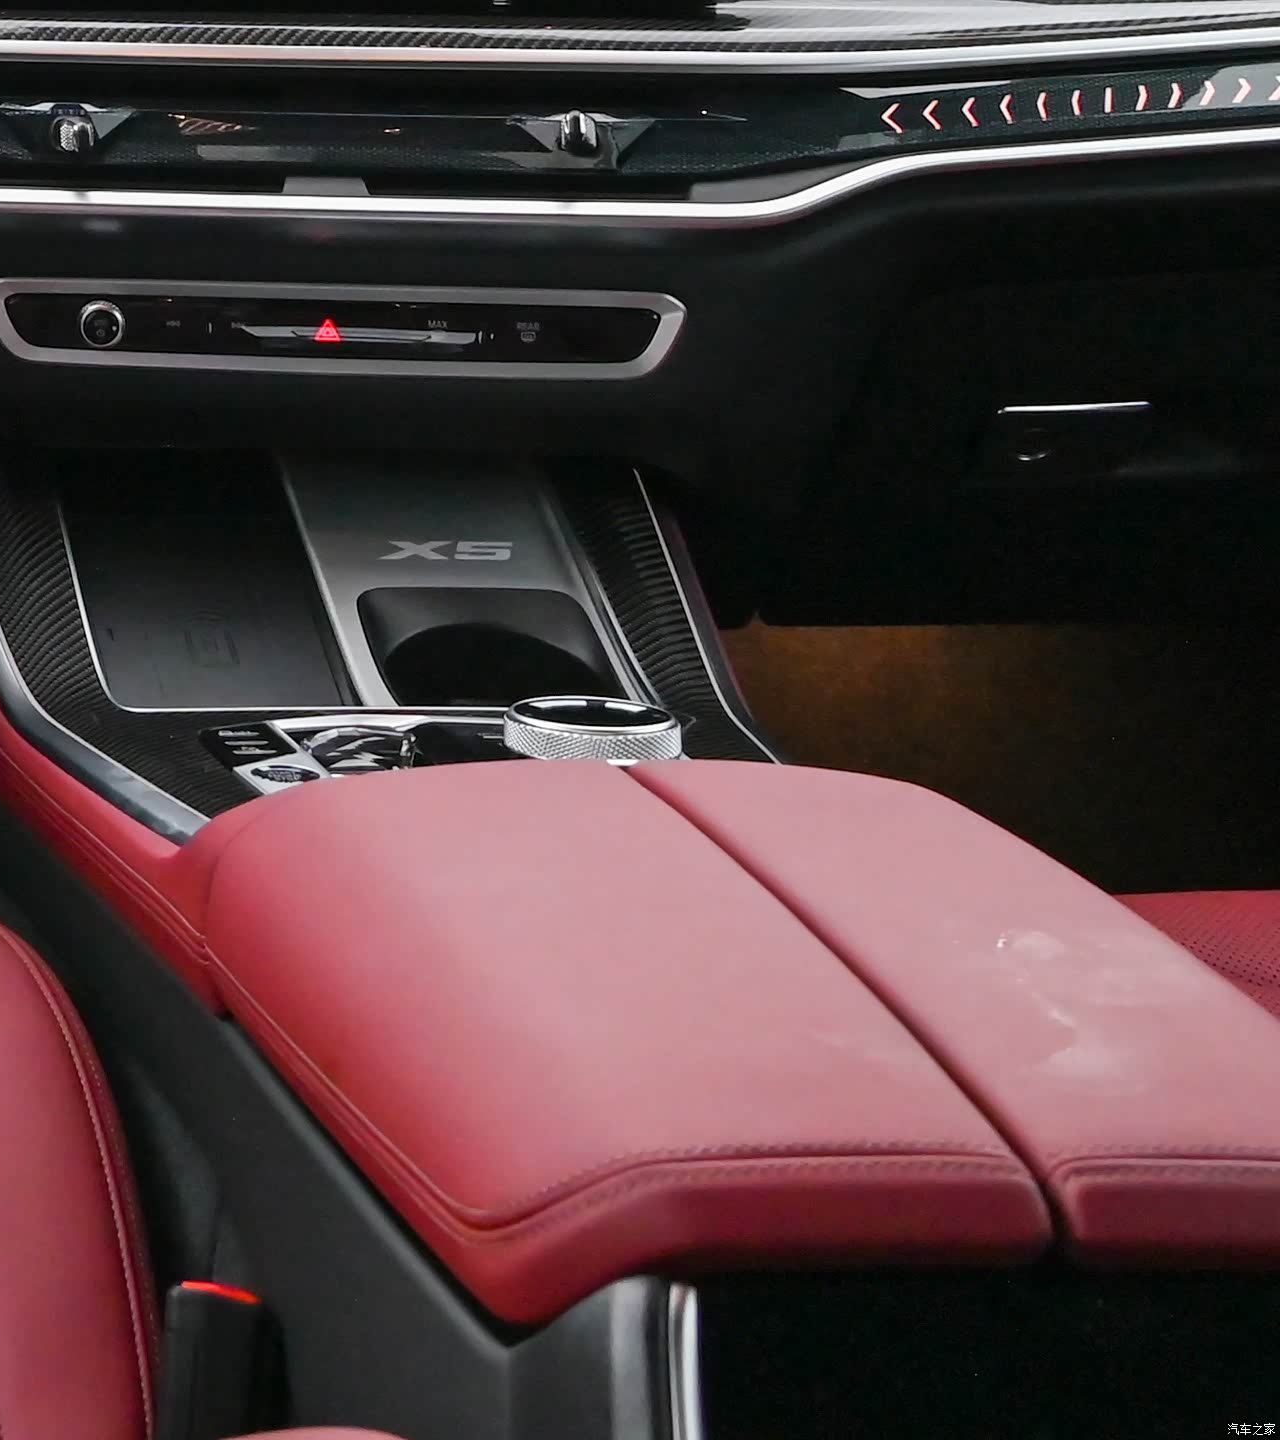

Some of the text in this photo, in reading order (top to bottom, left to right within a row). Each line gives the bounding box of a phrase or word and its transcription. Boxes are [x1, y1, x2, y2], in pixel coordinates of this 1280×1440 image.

[427, 319, 449, 329] MAX
[516, 321, 541, 331] REAR
[377, 540, 513, 561] X5
